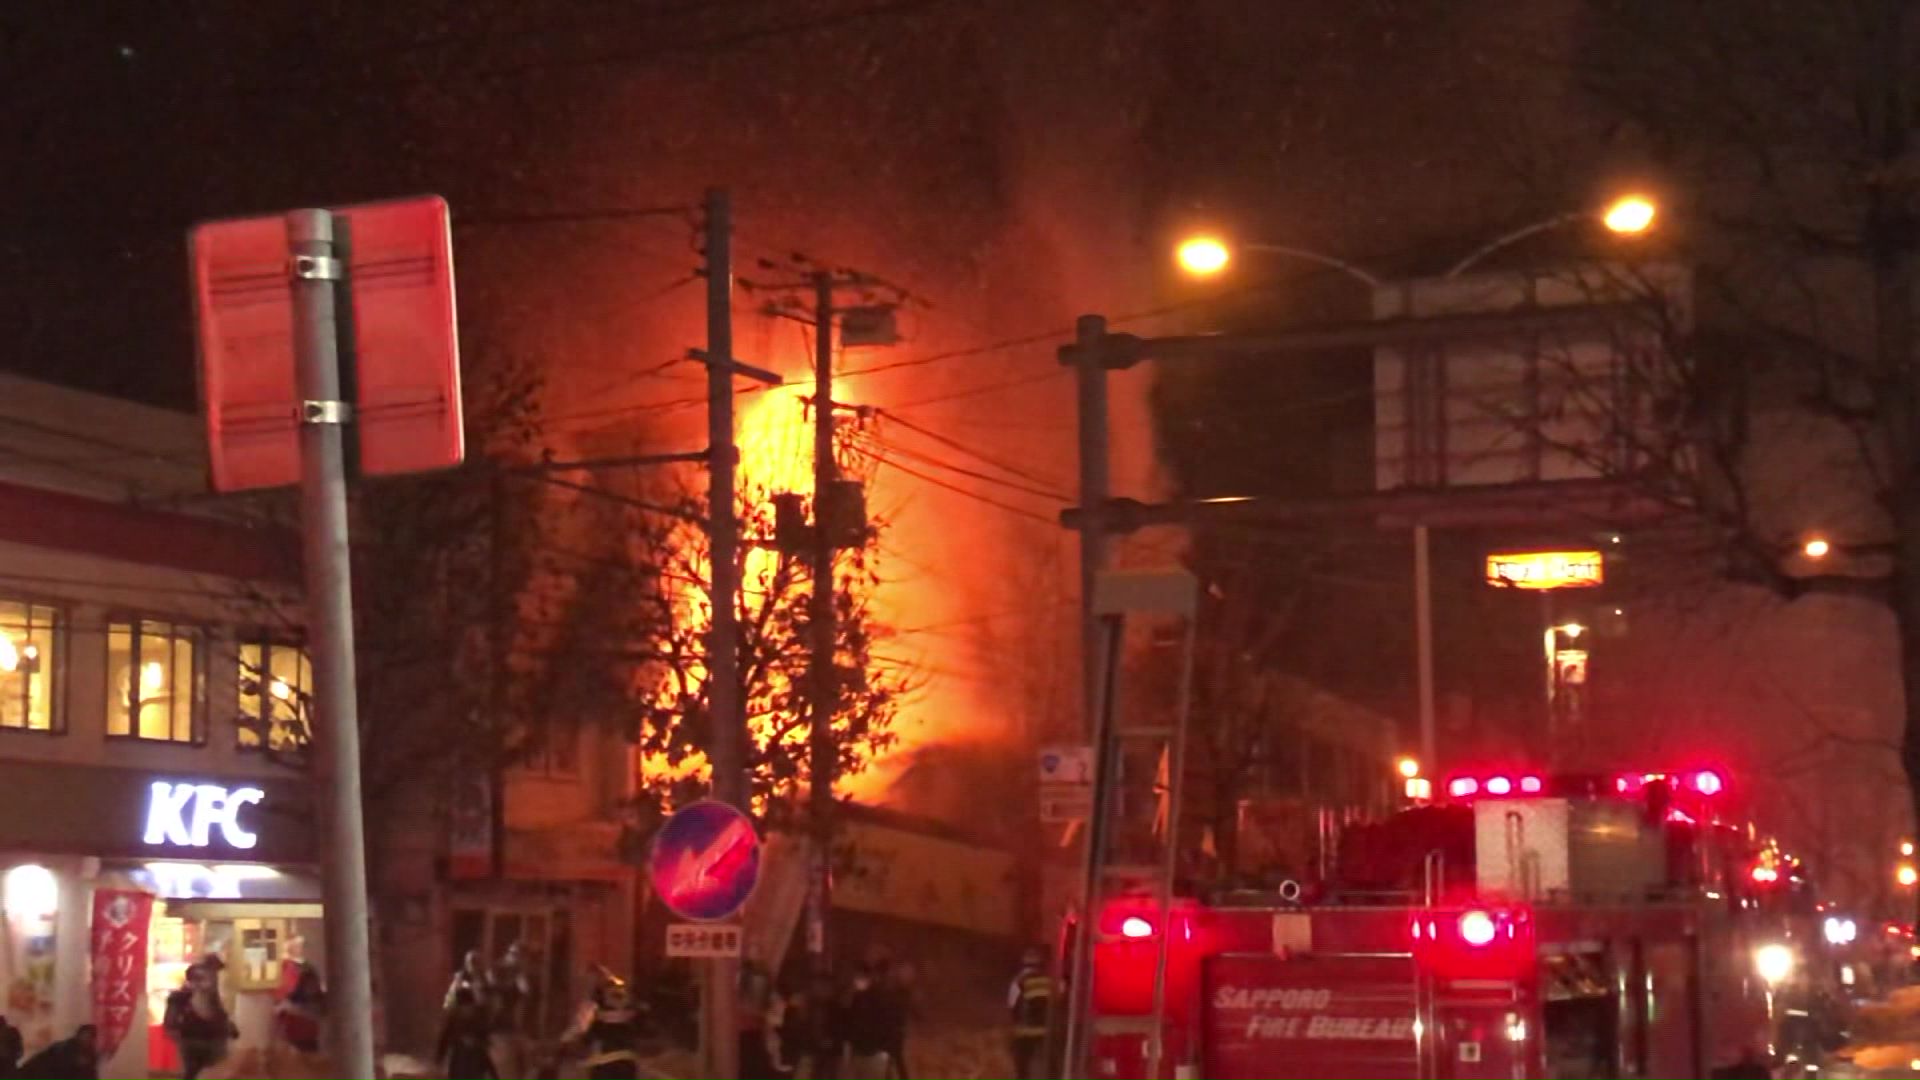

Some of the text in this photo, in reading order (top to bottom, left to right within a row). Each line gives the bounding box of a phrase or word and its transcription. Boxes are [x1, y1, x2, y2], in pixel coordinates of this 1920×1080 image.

[143, 782, 264, 849] KFC
[1214, 986, 1332, 1010] SAPPORO
[1306, 1014, 1410, 1040] BUREAU
